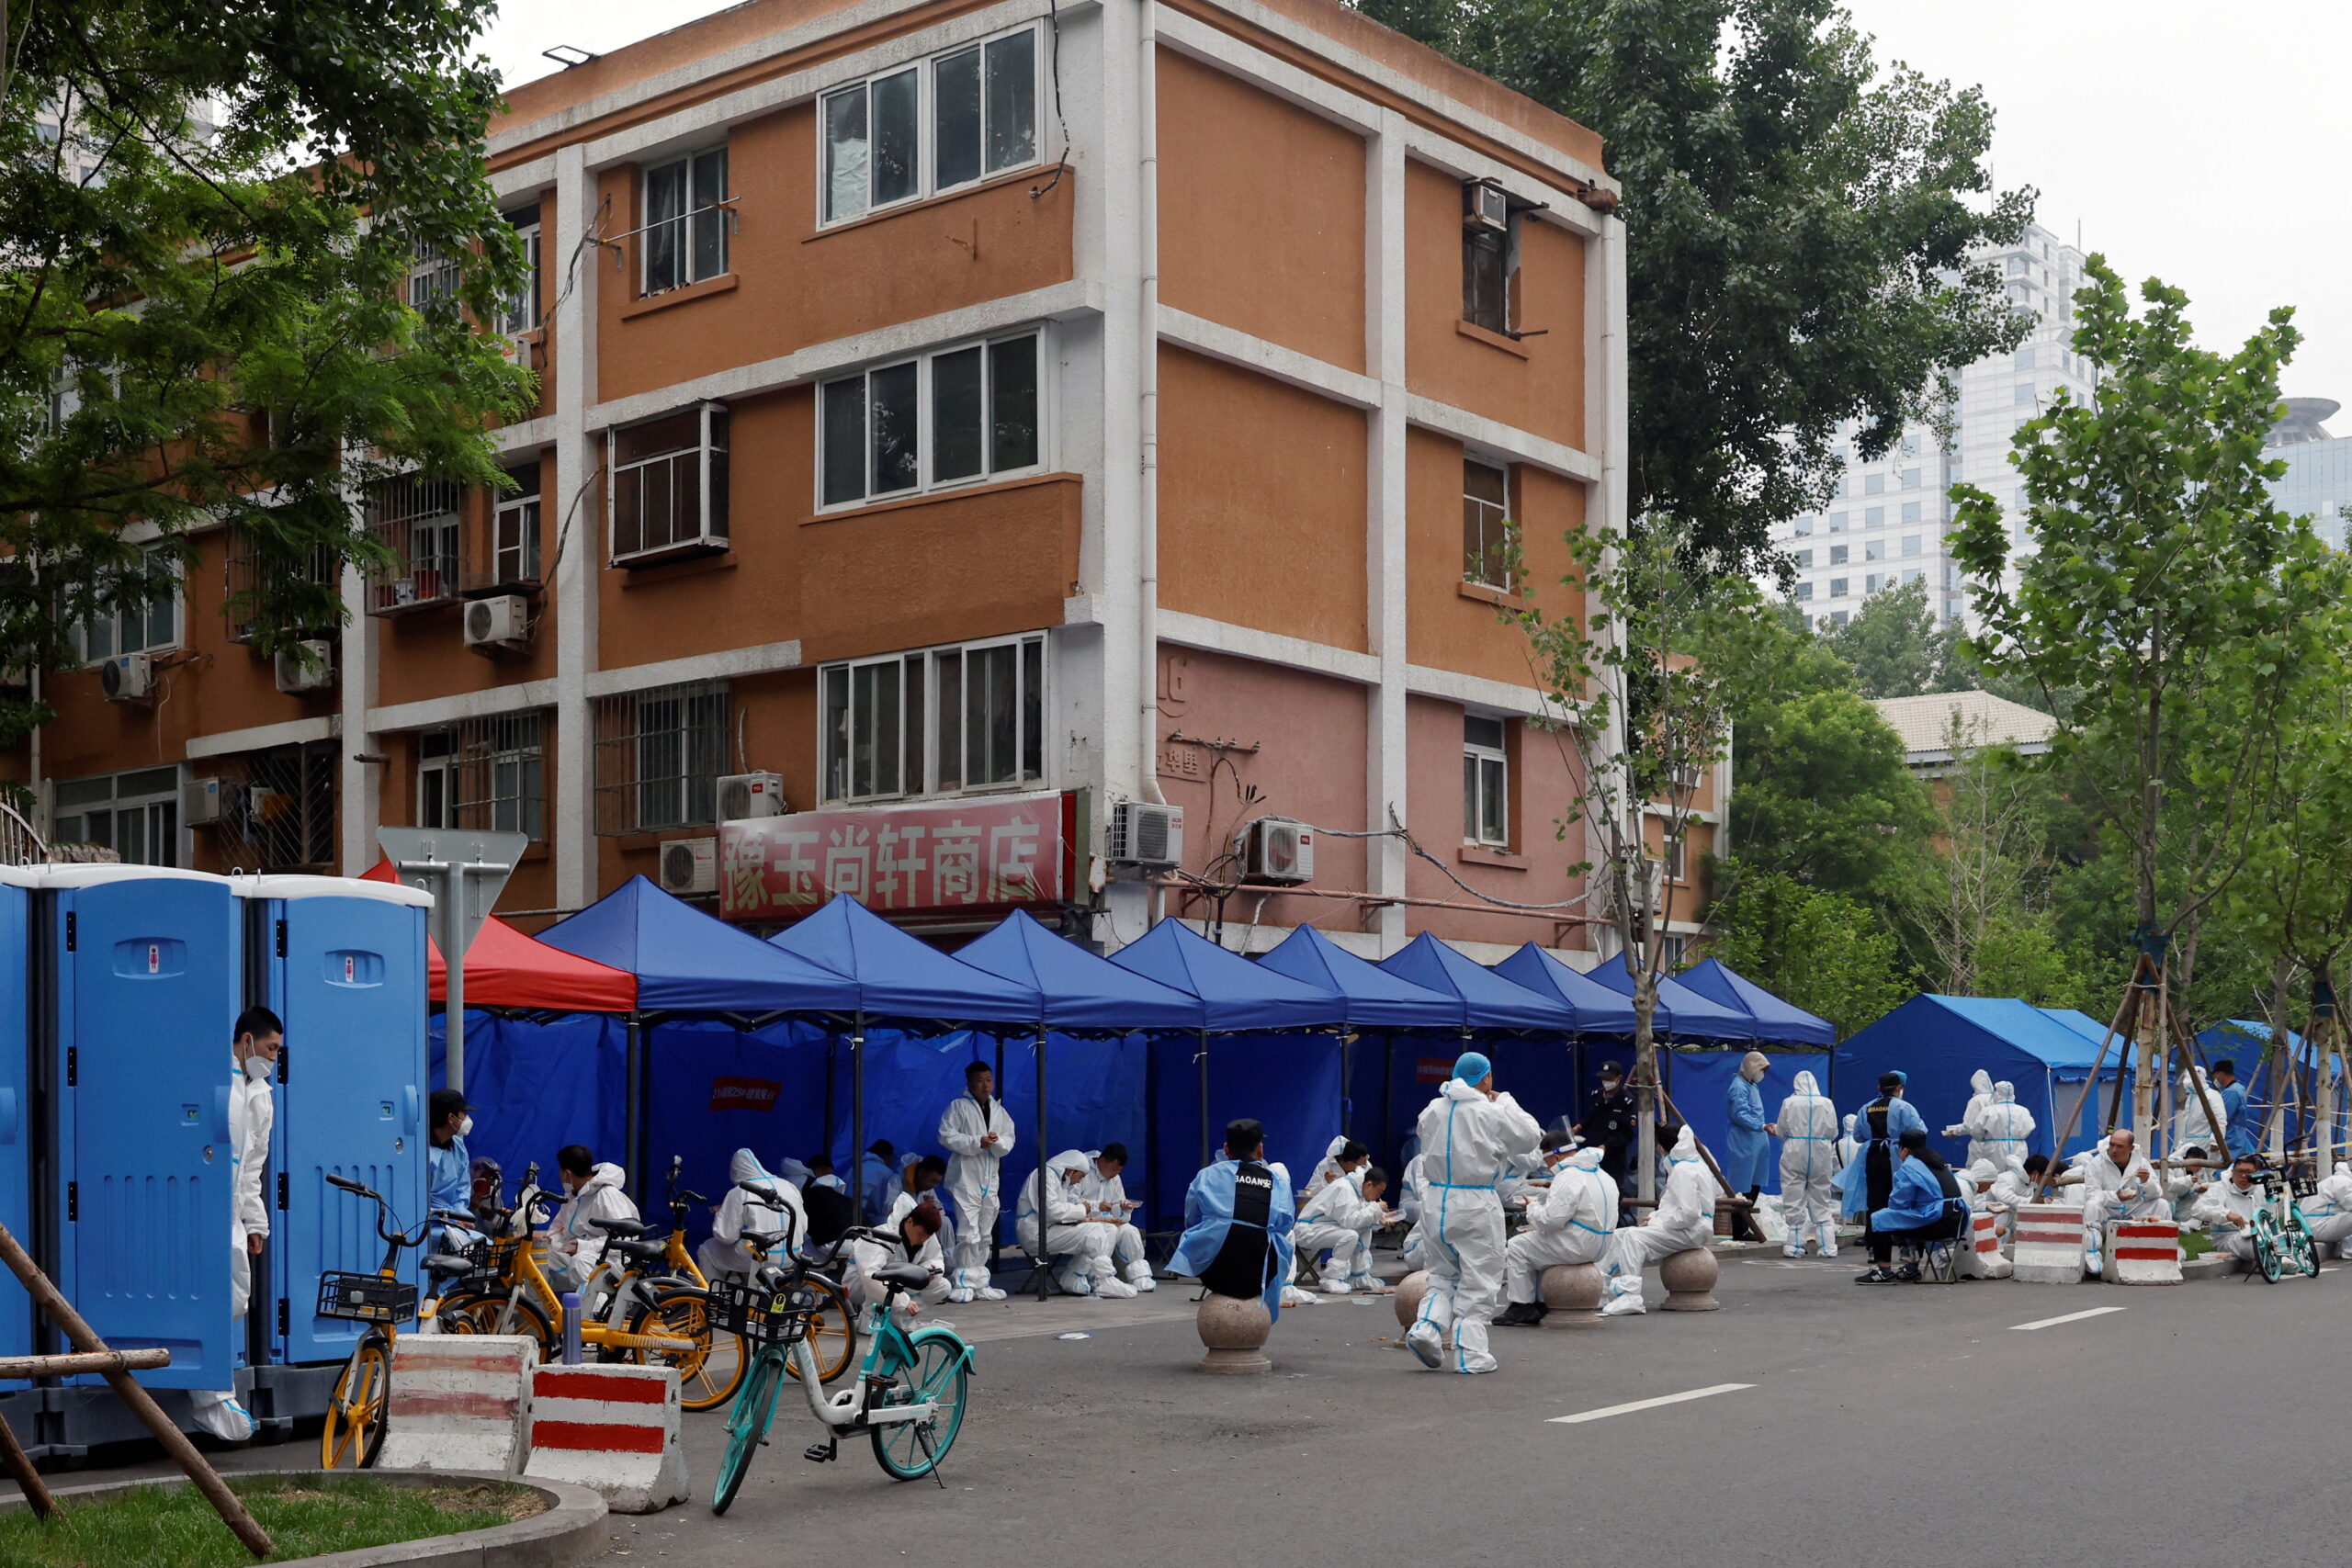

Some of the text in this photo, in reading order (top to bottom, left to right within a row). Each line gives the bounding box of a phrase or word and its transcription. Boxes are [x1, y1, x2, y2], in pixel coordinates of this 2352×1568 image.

[724, 817, 1040, 910] 豫玉尚轩商店
